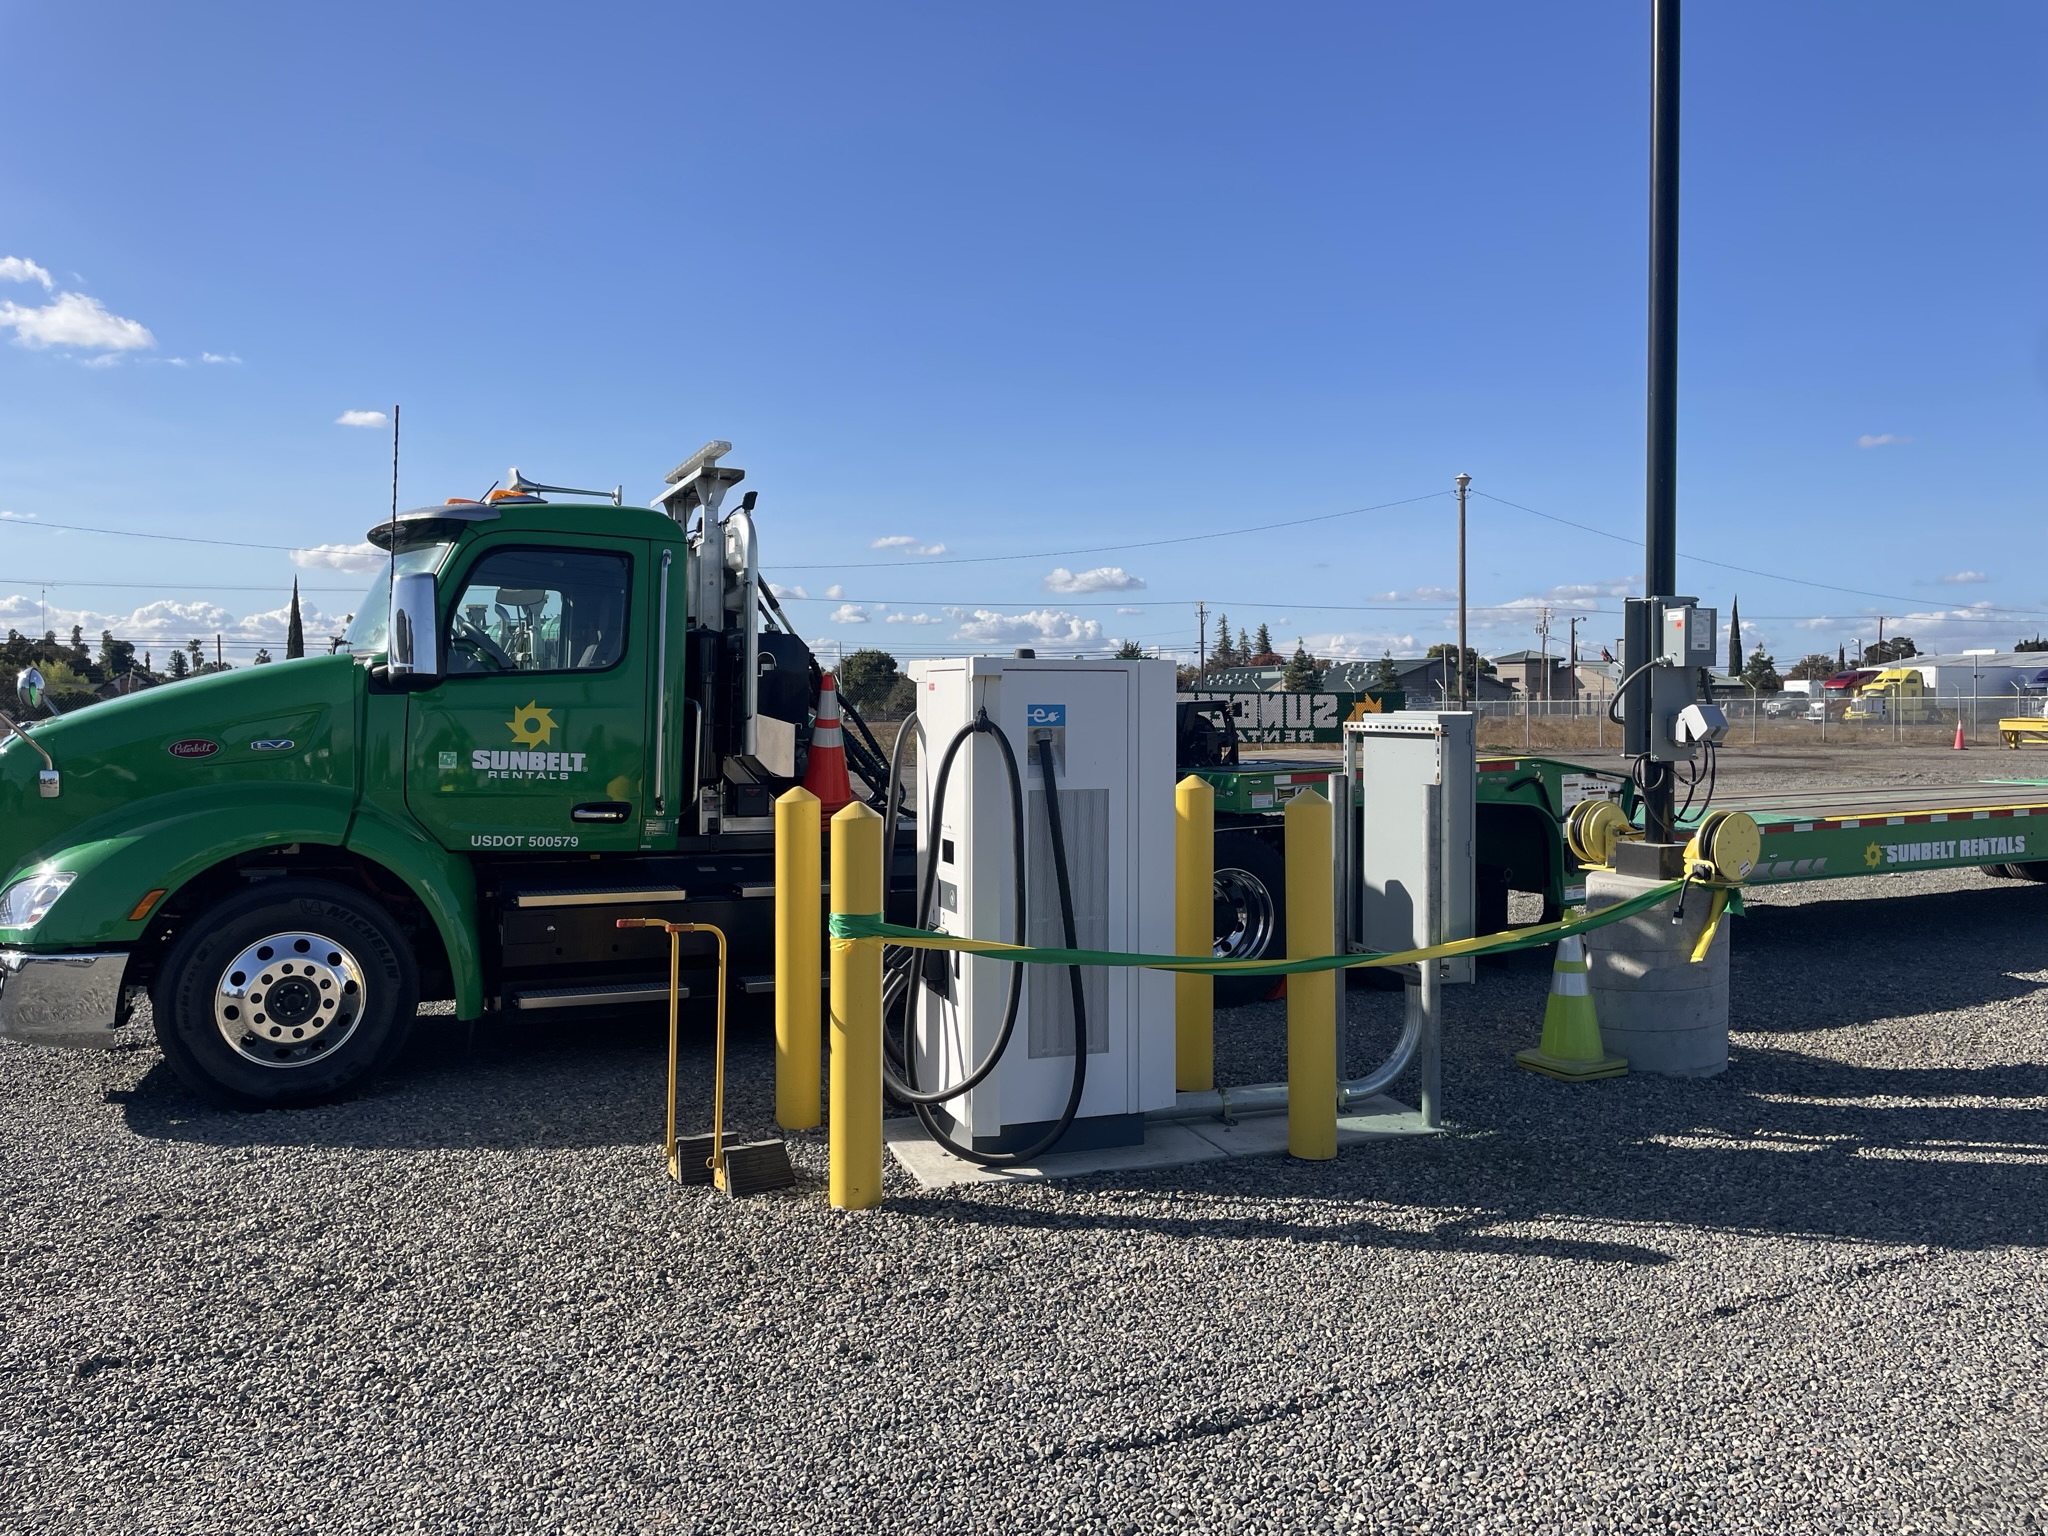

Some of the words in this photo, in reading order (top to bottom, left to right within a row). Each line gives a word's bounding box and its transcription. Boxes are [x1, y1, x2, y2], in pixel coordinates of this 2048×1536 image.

[174, 743, 214, 754] Peterbilt
[257, 741, 287, 749] EV
[472, 750, 586, 772] SUNBELT
[488, 771, 569, 780] RENTALS
[471, 835, 524, 847] USDOT
[528, 836, 579, 847] 500579
[1886, 840, 1956, 863] SUNBELT
[1960, 835, 2026, 857] RENTALS
[326, 905, 400, 979] MICHELIN
